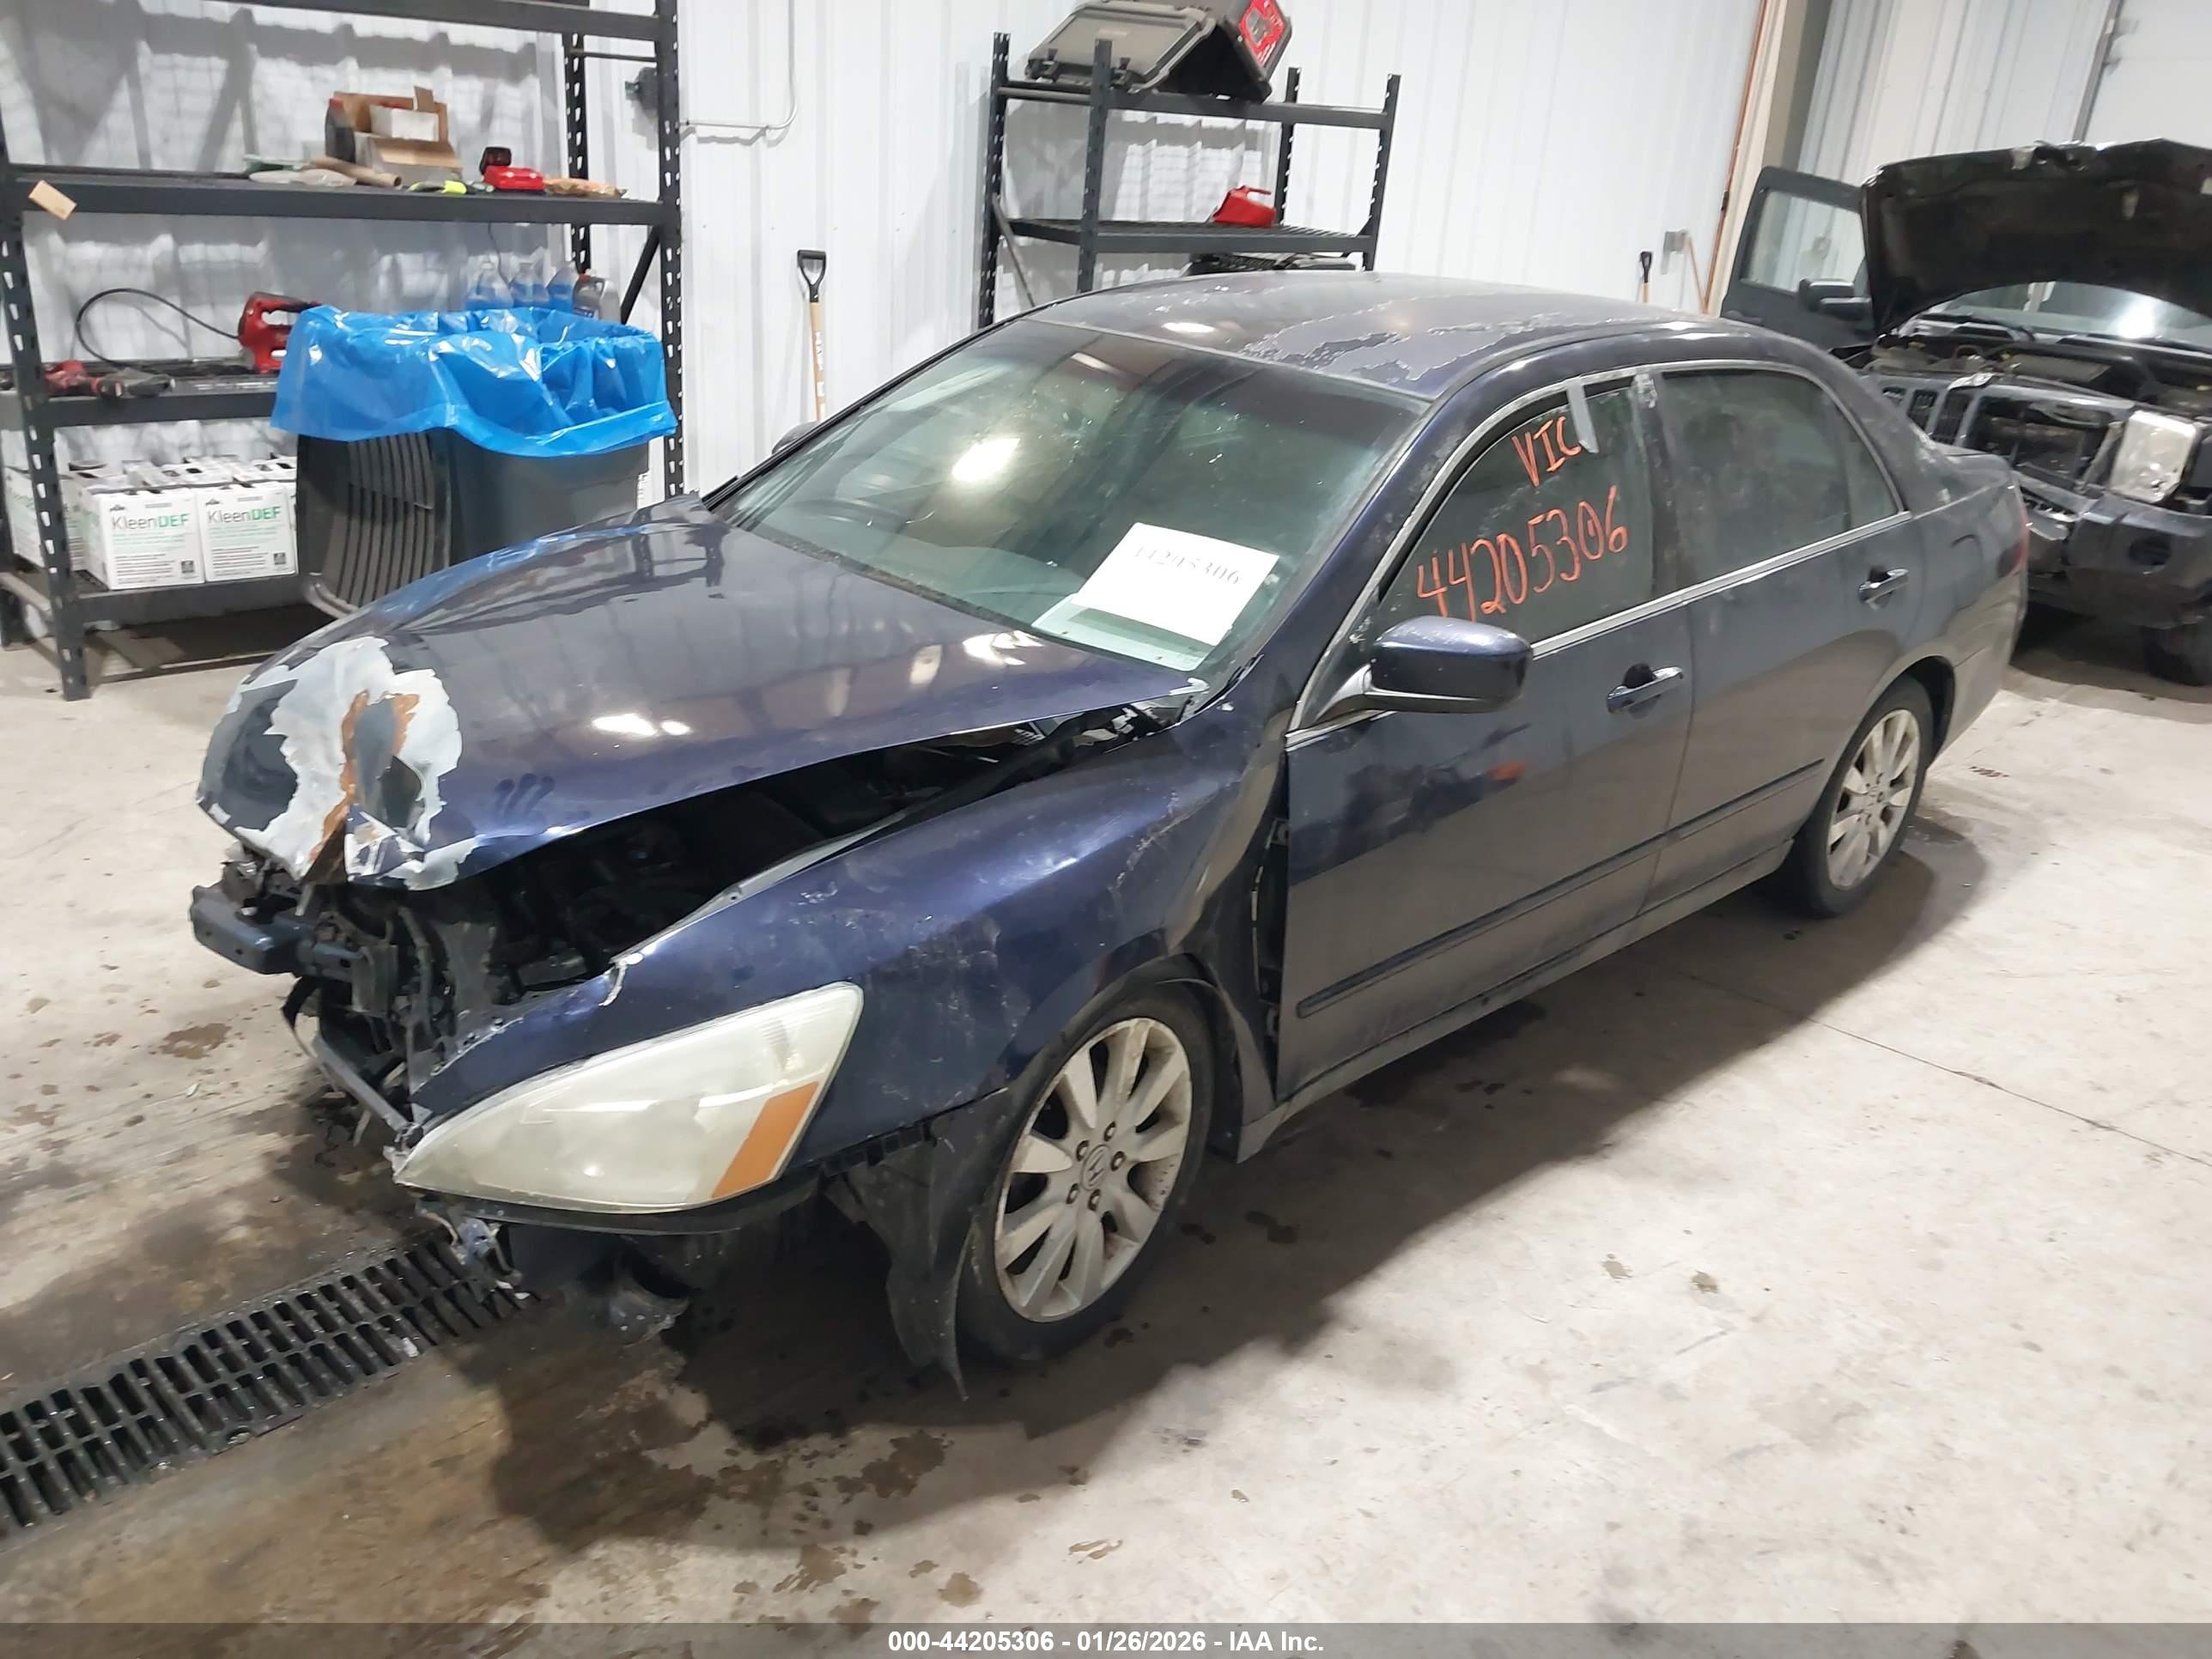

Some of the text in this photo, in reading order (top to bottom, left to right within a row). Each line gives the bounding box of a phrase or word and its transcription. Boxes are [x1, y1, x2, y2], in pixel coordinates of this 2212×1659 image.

[1511, 416, 1582, 488] VIC
[112, 514, 190, 530] KleenDEF
[208, 506, 282, 524] KleenDEF
[1417, 484, 1628, 623] 44205306
